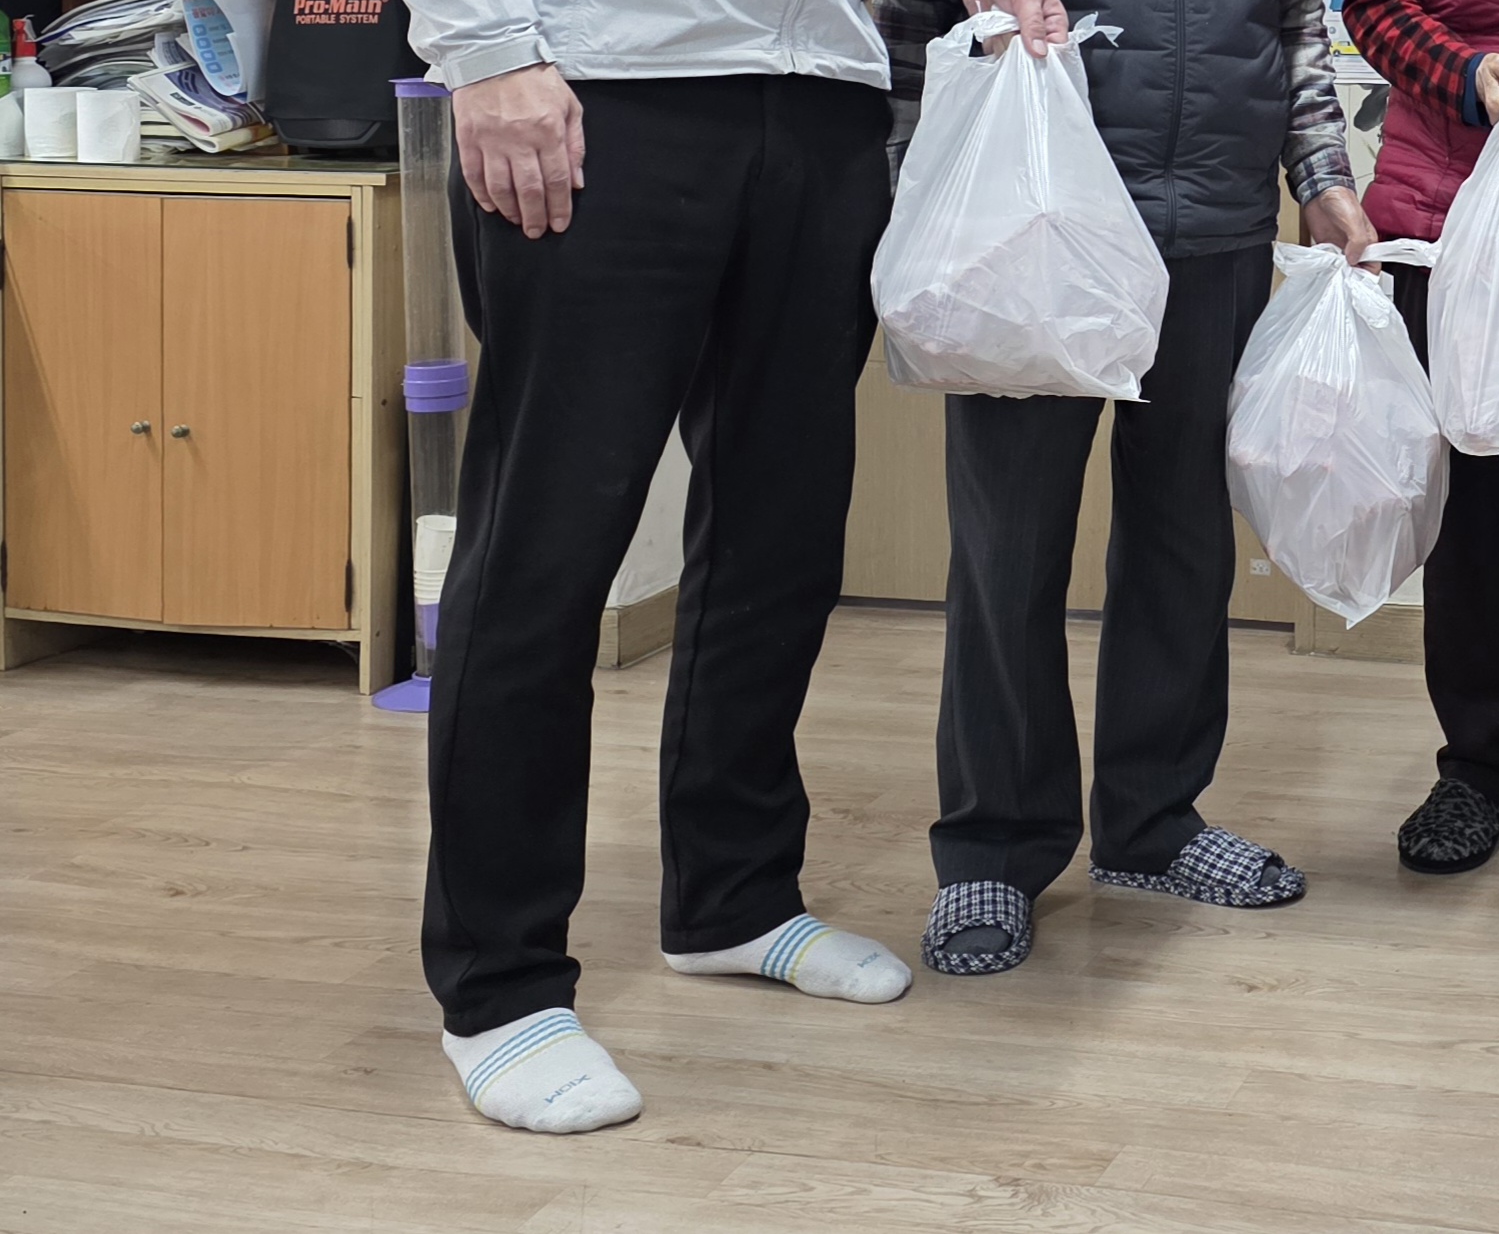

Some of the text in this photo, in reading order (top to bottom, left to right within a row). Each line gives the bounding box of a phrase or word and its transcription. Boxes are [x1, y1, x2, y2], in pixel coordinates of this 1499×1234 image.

[295, 14, 379, 25] PORTABLE SYSTEM
[543, 1074, 592, 1104] XIOM
